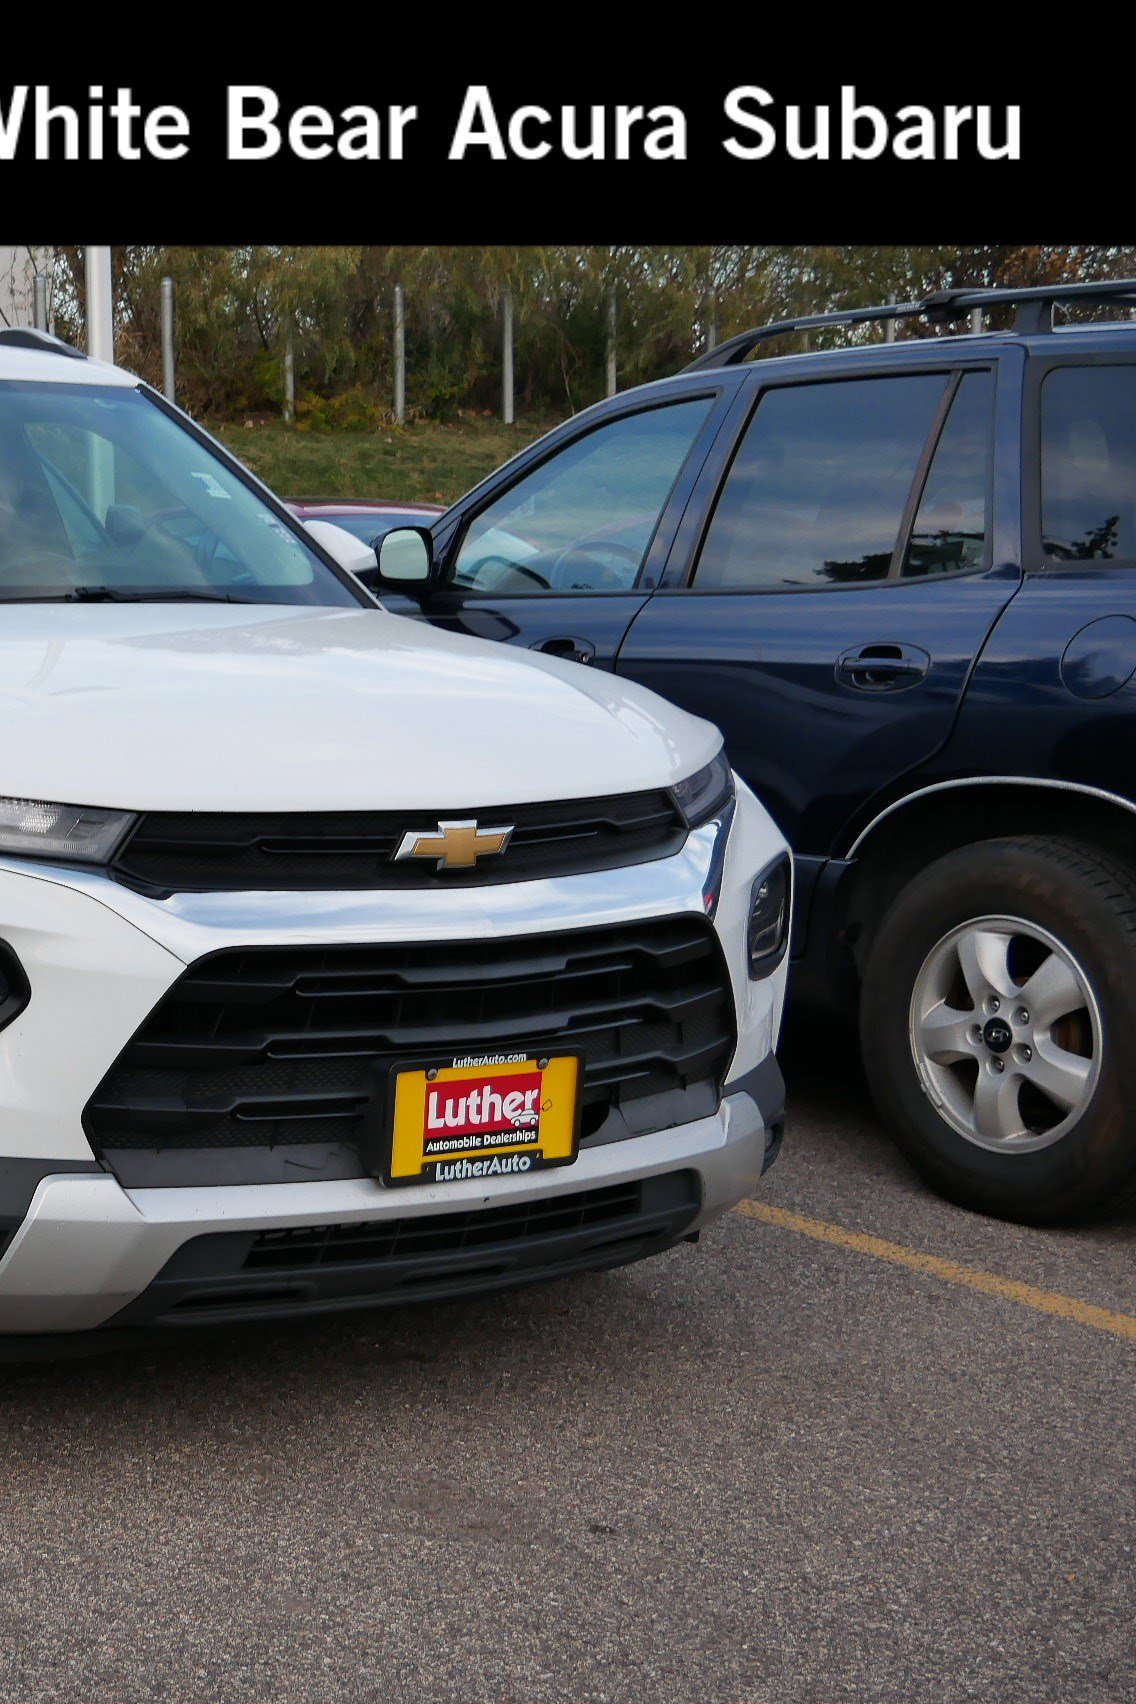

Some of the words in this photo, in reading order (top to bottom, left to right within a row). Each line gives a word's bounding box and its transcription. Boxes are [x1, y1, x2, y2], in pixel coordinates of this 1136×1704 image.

[452, 1053, 527, 1069] LutherAuto.com
[427, 1085, 539, 1130] Luther
[426, 1137, 482, 1153] Automobile
[483, 1130, 536, 1145] Dealerships
[435, 1154, 531, 1182] LutherAuto
